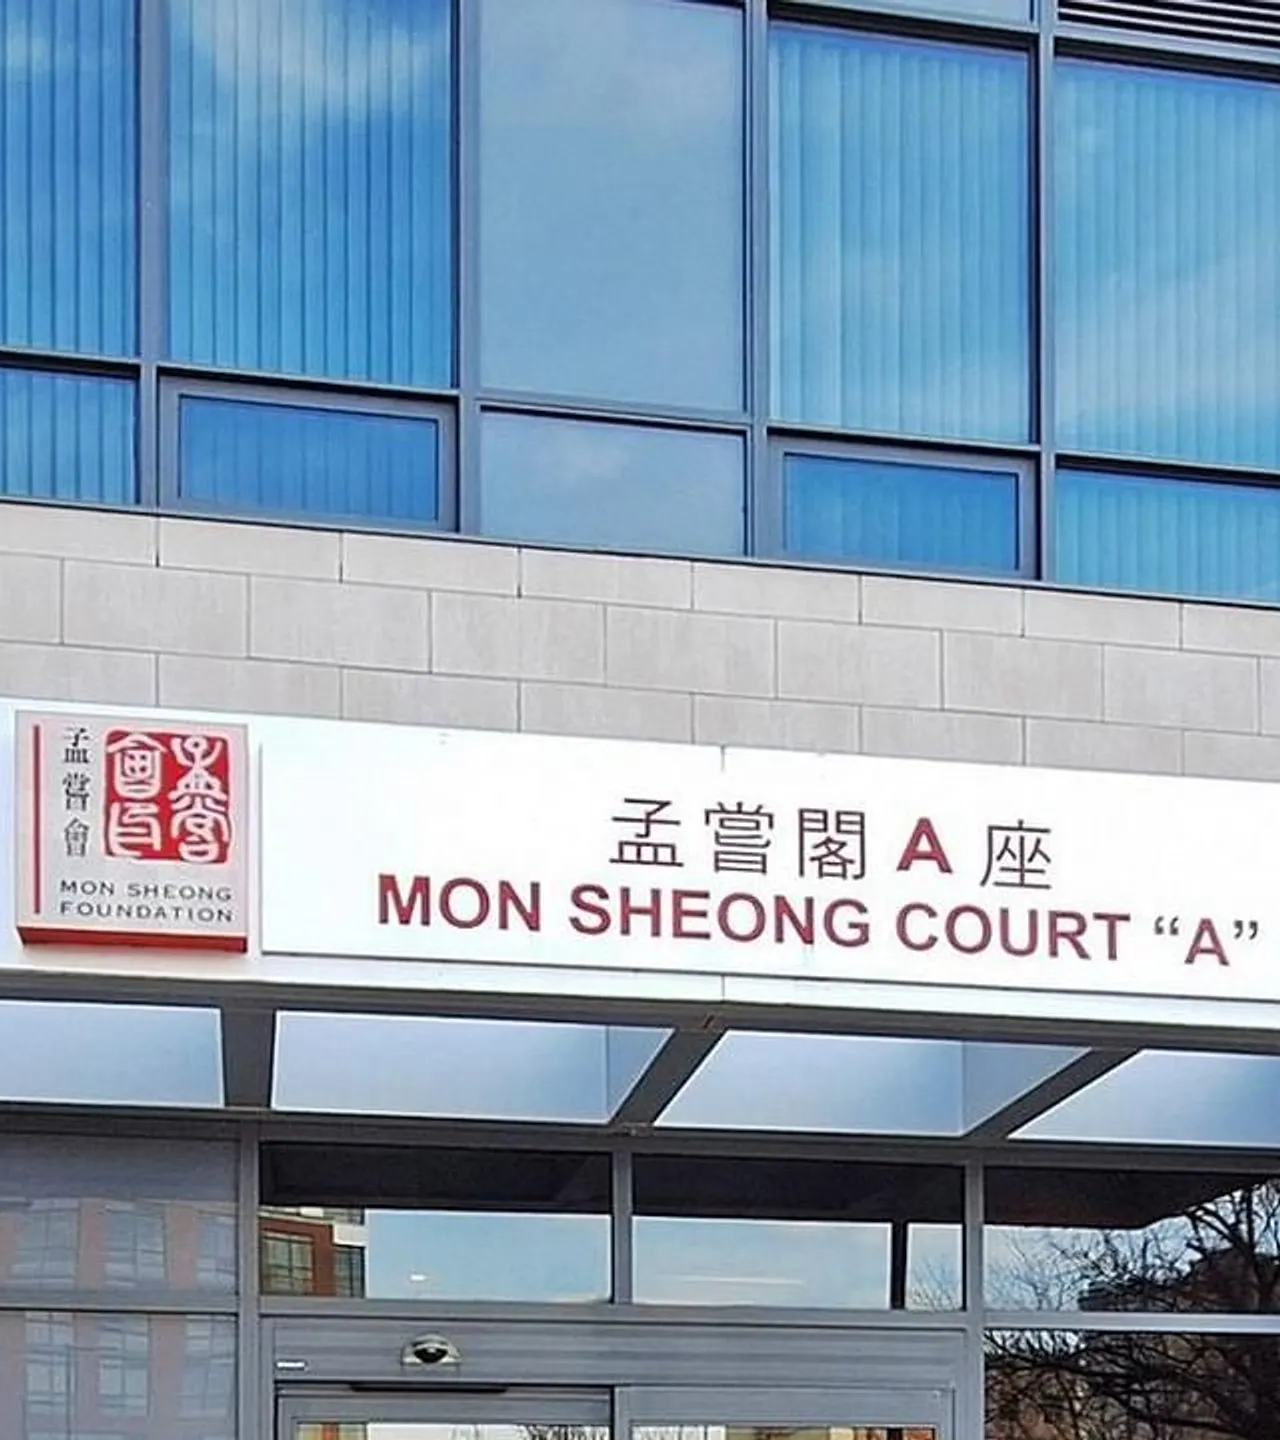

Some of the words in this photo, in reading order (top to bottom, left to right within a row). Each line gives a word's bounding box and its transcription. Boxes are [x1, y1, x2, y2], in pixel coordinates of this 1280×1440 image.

[60, 880, 115, 896] MON
[127, 884, 232, 901] SHEONG
[60, 902, 232, 923] FOUNDATION
[378, 873, 541, 931] MON
[569, 883, 871, 947] SHEONG
[895, 902, 1131, 961] COURT
